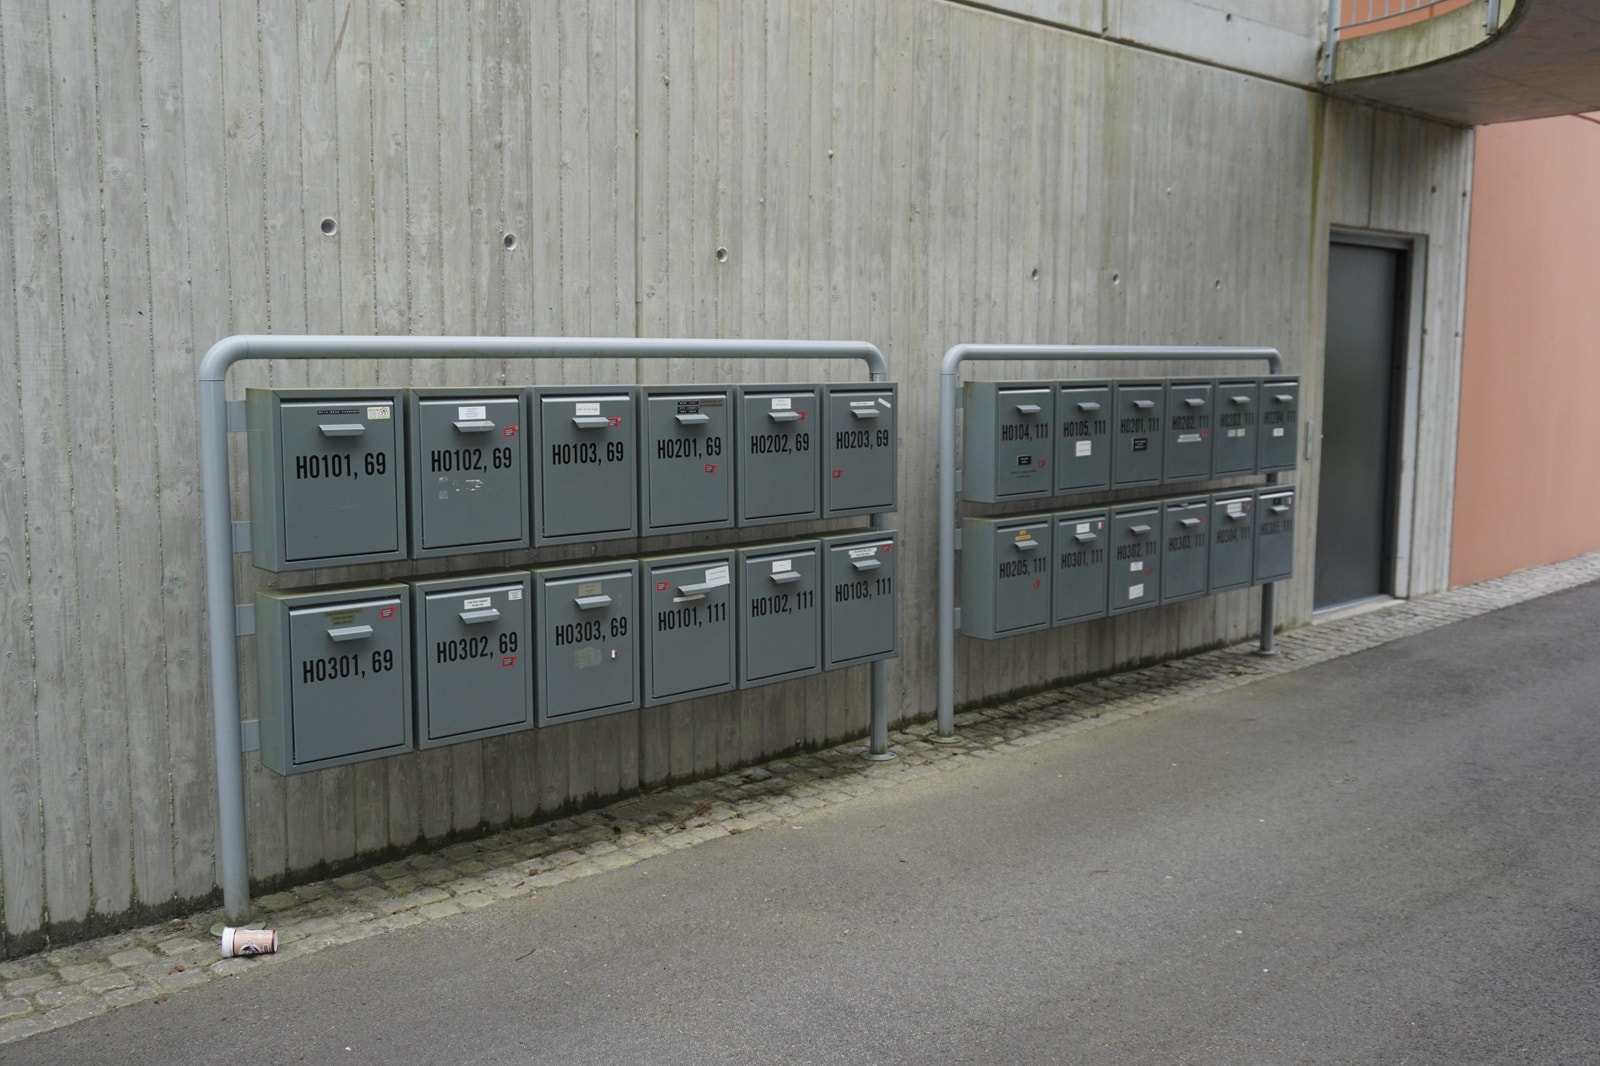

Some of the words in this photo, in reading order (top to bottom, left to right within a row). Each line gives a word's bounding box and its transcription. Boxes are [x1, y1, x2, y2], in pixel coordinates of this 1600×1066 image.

[1035, 423, 1049, 439] 111
[1093, 420, 1106, 435] 111
[1148, 417, 1160, 432] 111
[1198, 415, 1210, 429] 111
[705, 436, 722, 456] 69
[795, 432, 810, 452] 69
[876, 429, 889, 447] 69
[492, 447, 512, 469] 69
[606, 441, 624, 462] 69
[364, 452, 386, 475] 69
[1091, 548, 1103, 565] 111
[1145, 540, 1157, 556] 111
[1033, 556, 1047, 573] 111
[876, 577, 892, 595] 111
[796, 590, 814, 610] 111
[706, 602, 727, 623] 111
[610, 616, 628, 637] 69
[499, 631, 518, 654] 69
[372, 649, 393, 672] 69
